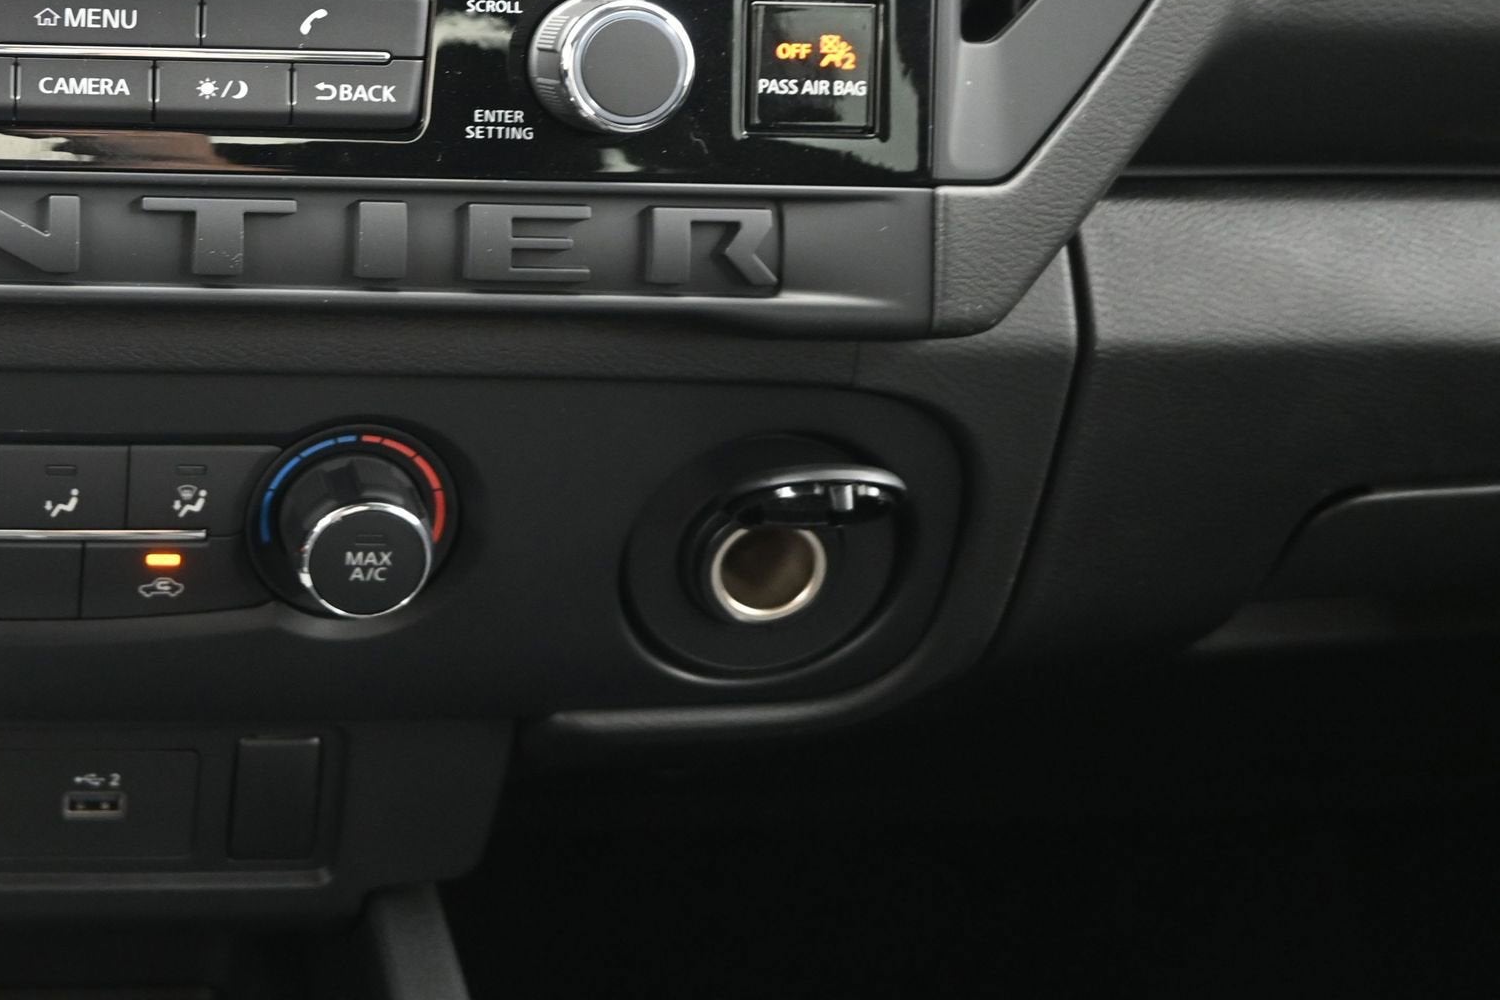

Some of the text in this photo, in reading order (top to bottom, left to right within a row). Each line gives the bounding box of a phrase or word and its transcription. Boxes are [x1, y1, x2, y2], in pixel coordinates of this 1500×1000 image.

[465, 0, 524, 14] SCROLL
[64, 7, 138, 30] MENU
[775, 42, 812, 60] OFF
[37, 76, 131, 97] CAMERA
[337, 84, 397, 103] BACK
[757, 78, 868, 96] PASS AIR BAG
[473, 109, 525, 125] ENTER
[464, 125, 535, 141] SETTING
[345, 550, 393, 567] MAX
[348, 566, 388, 583] A/C
[108, 773, 122, 787] 2
